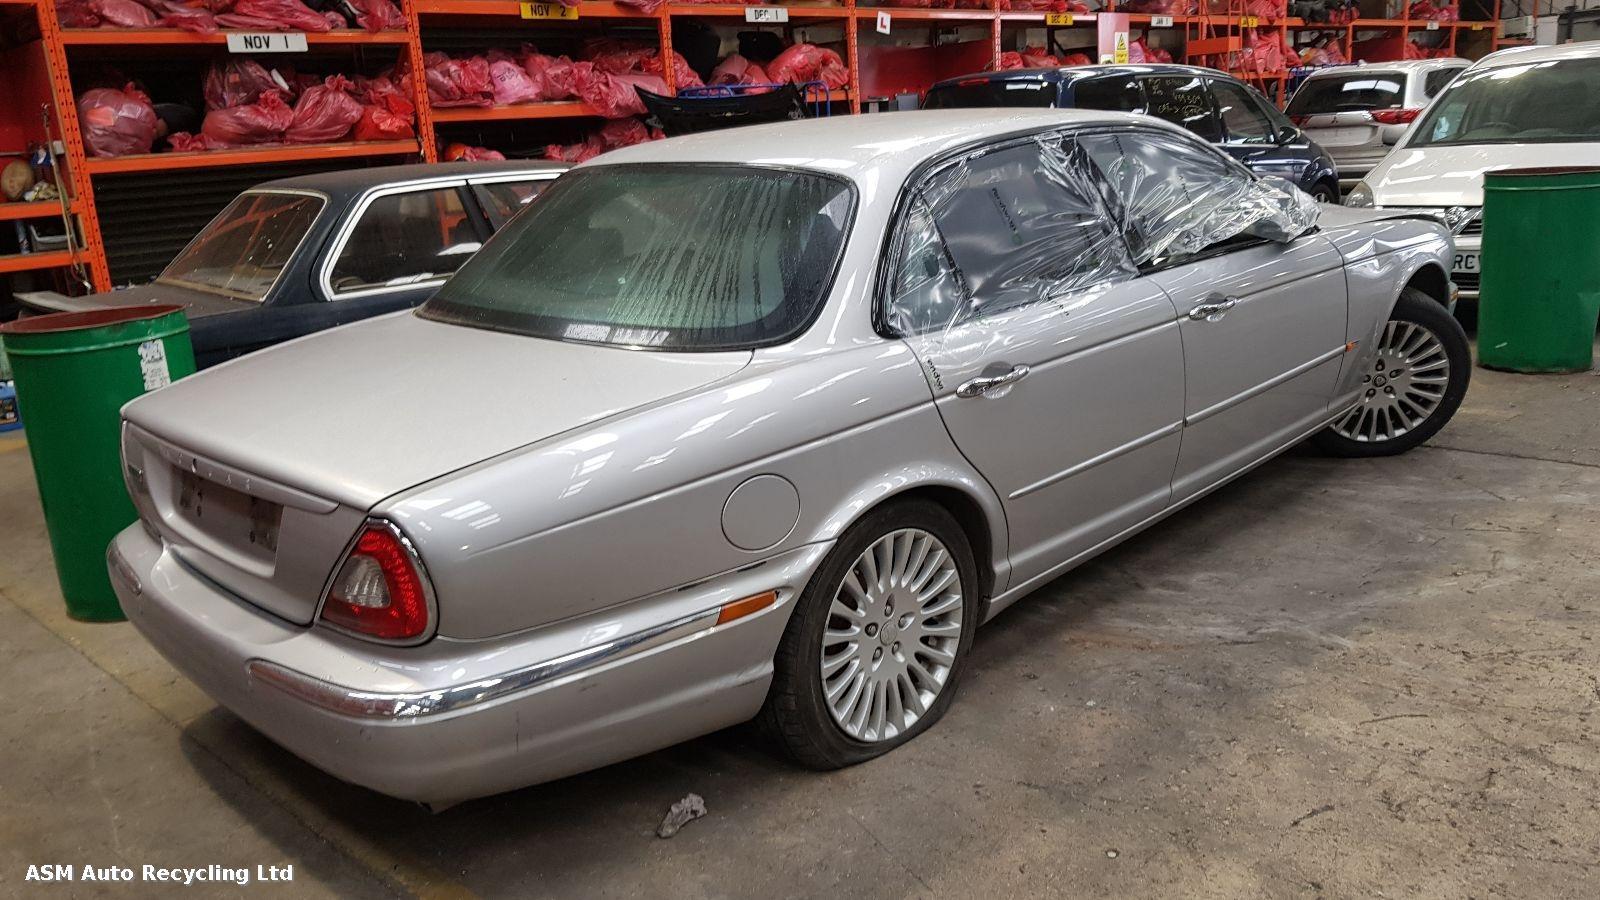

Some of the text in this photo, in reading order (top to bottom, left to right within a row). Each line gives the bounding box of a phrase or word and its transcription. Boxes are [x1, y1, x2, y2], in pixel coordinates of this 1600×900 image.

[530, 3, 567, 17] NOV 2
[880, 16, 887, 30] L
[243, 35, 289, 49] NOV 1
[1452, 254, 1481, 269] RC
